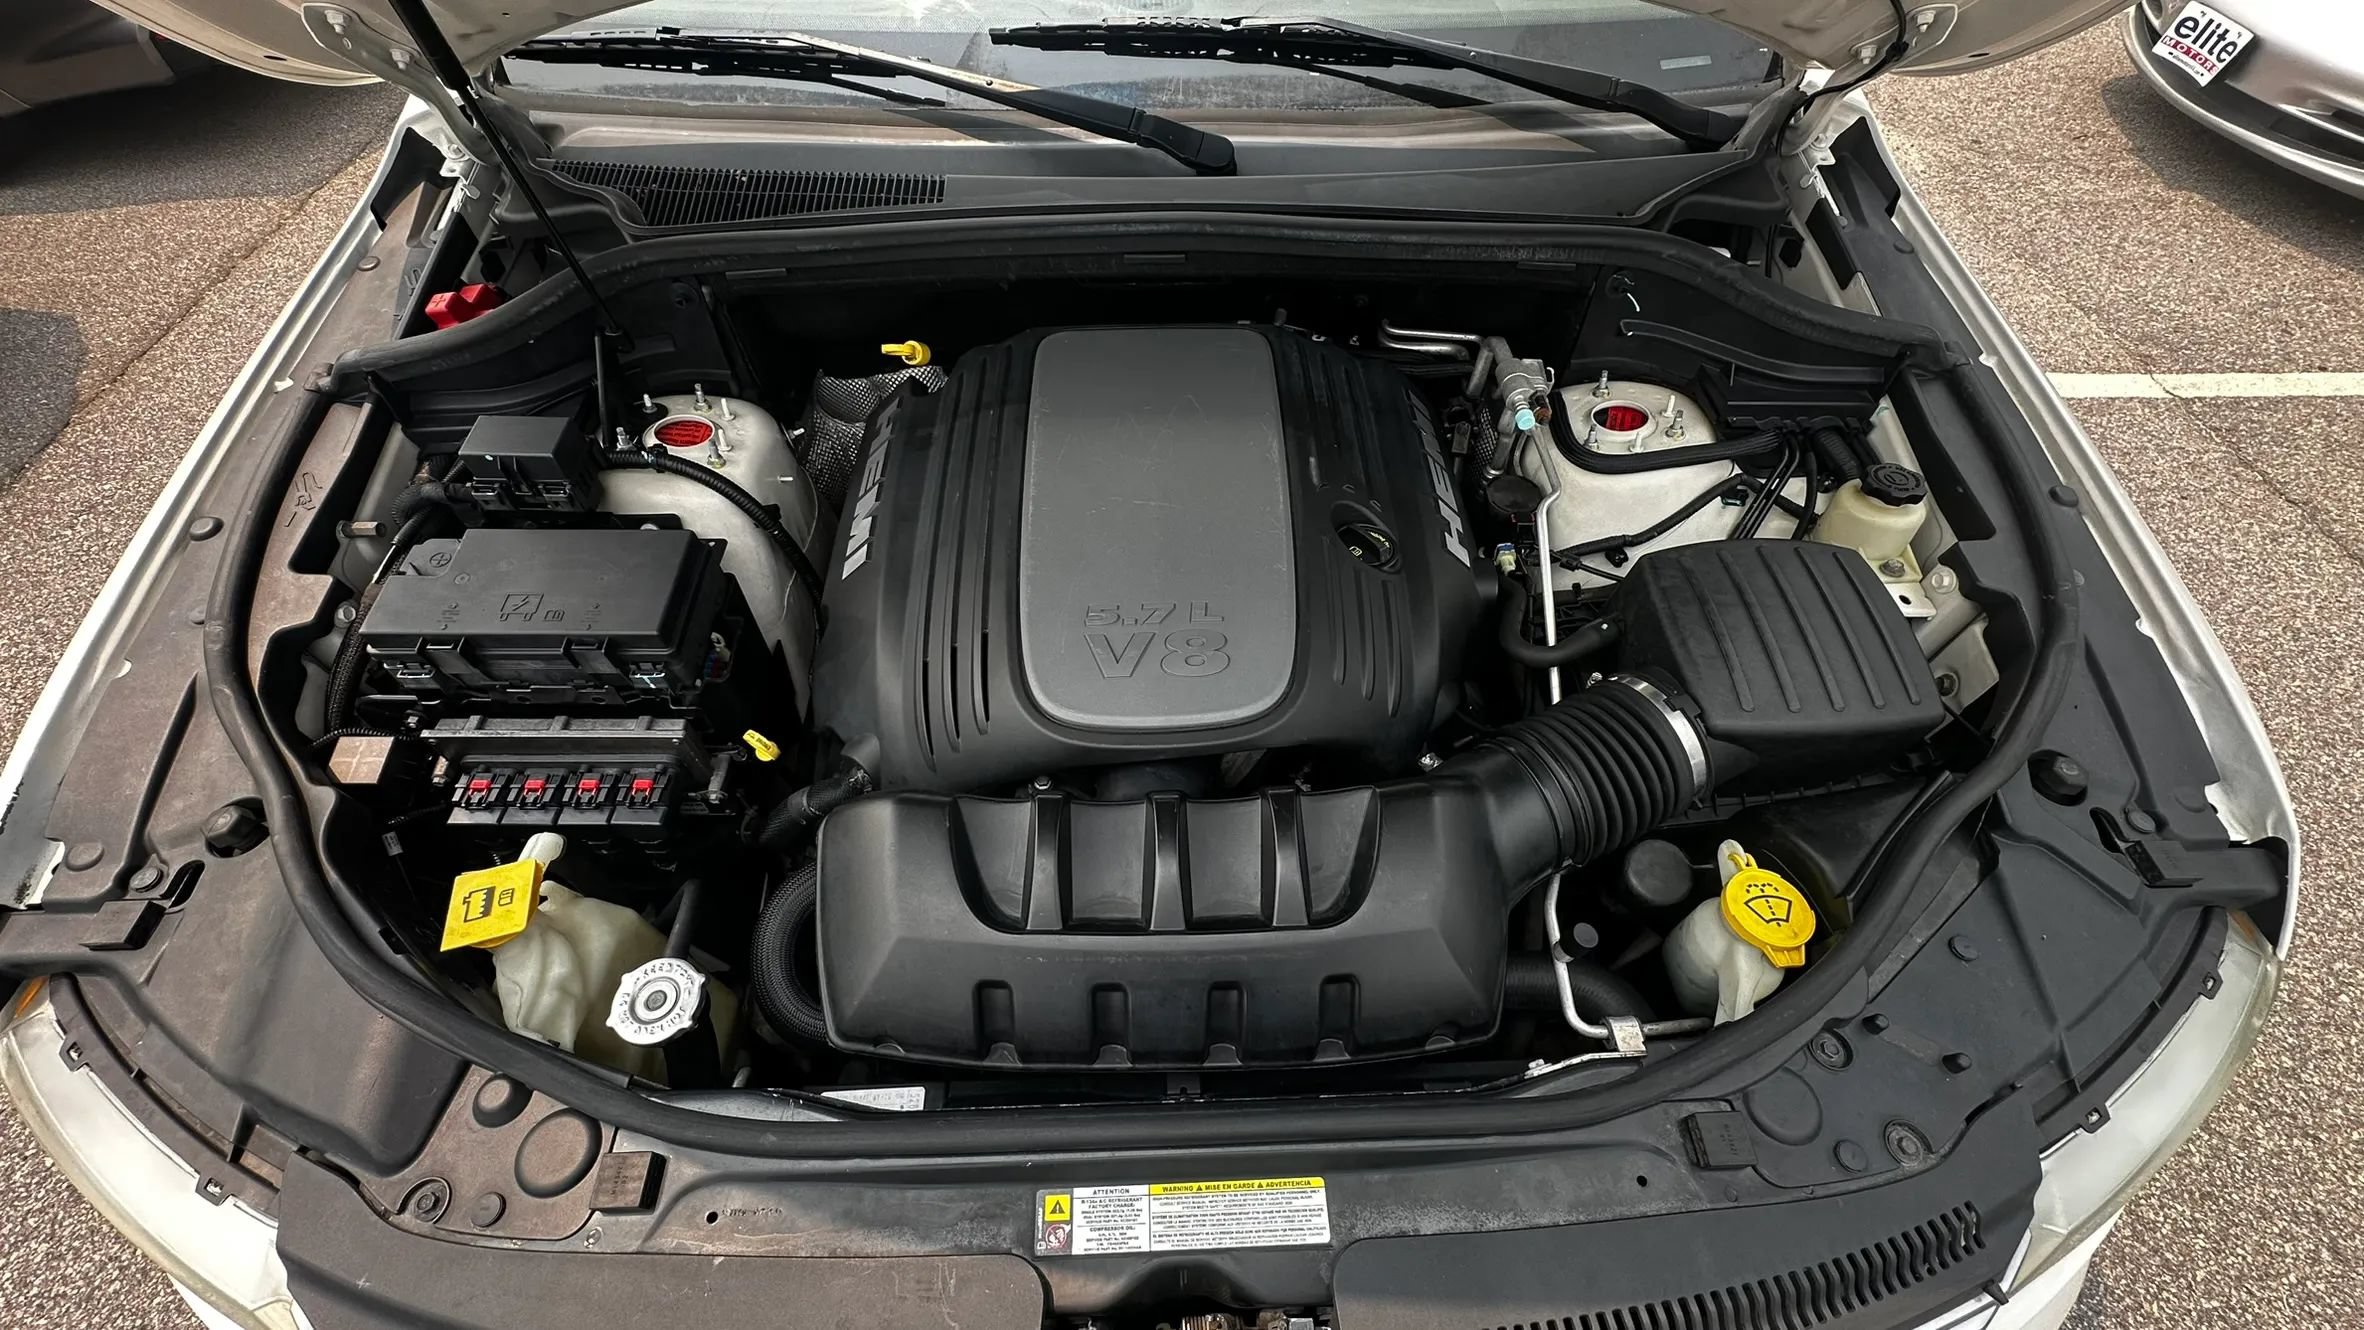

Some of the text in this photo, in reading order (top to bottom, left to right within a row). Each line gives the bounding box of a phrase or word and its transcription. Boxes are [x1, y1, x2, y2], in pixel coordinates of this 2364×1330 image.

[2162, 36, 2219, 76] MOTORS
[2174, 16, 2238, 63] elite
[842, 396, 899, 580] HEMI
[1408, 390, 1470, 567] HEMI
[1083, 628, 1231, 680] V8
[1162, 1185, 1194, 1193] WARNING
[1233, 1182, 1255, 1190] GARDE
[1265, 1180, 1312, 1188] ADVERTENCIA
